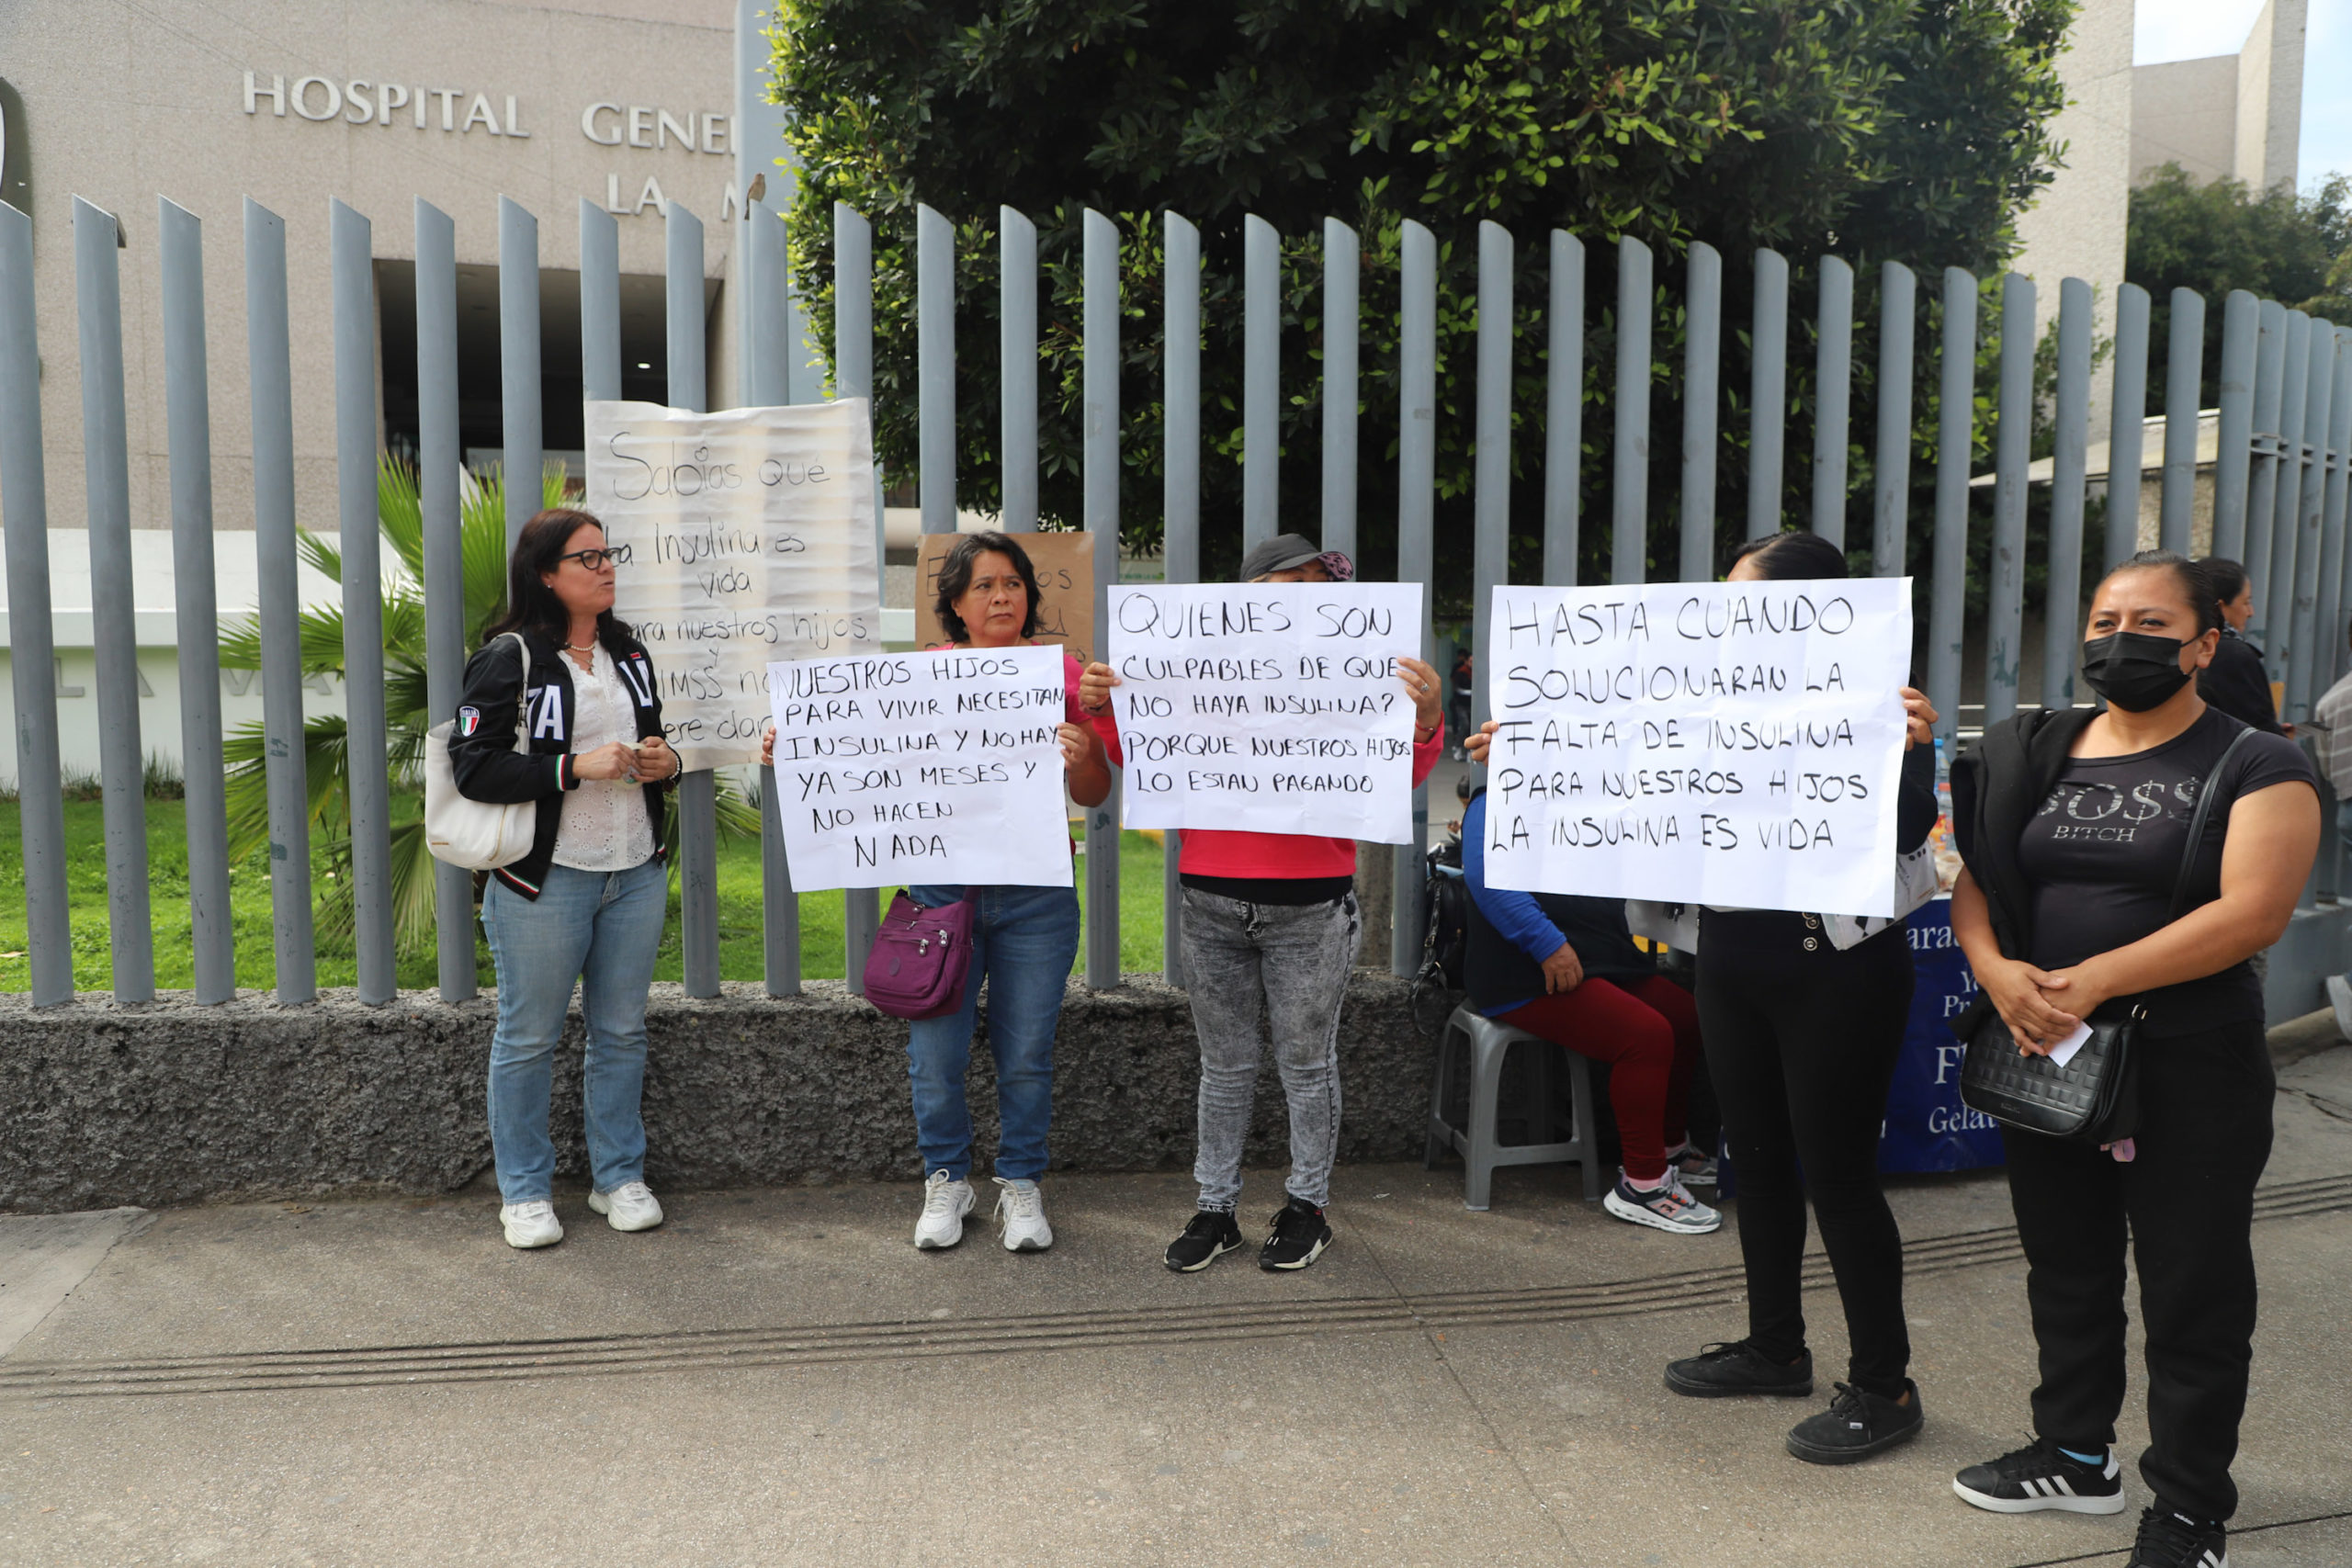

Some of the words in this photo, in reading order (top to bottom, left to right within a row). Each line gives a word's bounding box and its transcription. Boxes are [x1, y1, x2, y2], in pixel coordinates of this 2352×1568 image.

[243, 70, 531, 139] HOSPITAL
[581, 102, 736, 156] GENE
[607, 173, 667, 218] LA
[609, 431, 742, 501] Sabias
[655, 515, 761, 566] Insulina
[775, 531, 806, 553] es
[631, 620, 666, 644] ara
[677, 612, 778, 644] nuestros
[1118, 592, 1292, 639] QUIENES
[1315, 603, 1392, 638] SON
[1507, 599, 1650, 649] HASTA
[1675, 593, 1855, 641] CUANDO
[775, 660, 912, 700] NUESTROS
[932, 656, 1020, 681] HIJOS
[1122, 655, 1283, 682] CULPABLES
[1297, 655, 1331, 681] DE
[1343, 656, 1398, 680] QUE
[1504, 665, 1787, 709] SOLUCIONARAN
[1805, 662, 1845, 693] LA
[786, 699, 864, 727] PARA
[877, 698, 944, 720] VIVIR
[956, 687, 1065, 715] NECESITAN
[1129, 693, 1173, 720] NO
[1193, 693, 1250, 717] HAYA
[1264, 692, 1395, 716] INSULINA?
[784, 732, 942, 761] INSULINA
[954, 729, 968, 752] Y
[1122, 730, 1238, 763] PORQUE
[1251, 736, 1358, 758] NUESTROS
[1366, 737, 1411, 761] HIJOS
[1498, 718, 1619, 756] FALTA
[1643, 718, 1685, 750] DE
[1708, 717, 1854, 751] INSULINA
[797, 771, 836, 802] YA
[842, 769, 902, 792] SON
[920, 762, 1010, 786] MESES
[1023, 761, 1037, 779] Y
[1136, 768, 1173, 793] LO
[1188, 770, 1260, 793] ESTAN
[1272, 772, 1374, 794] PAGANDO
[1498, 768, 1583, 806] PARA
[1601, 768, 1745, 798] NUESTROS
[1768, 769, 1869, 804] HIJOS
[811, 807, 854, 834] NO
[873, 801, 954, 823] HACEN
[1491, 815, 1531, 852] LA
[1552, 815, 1681, 849] INSULINA
[1700, 814, 1739, 852] ES
[1758, 818, 1835, 852] VIDA
[2051, 825, 2139, 842] BITCH
[854, 833, 947, 868] NADA
